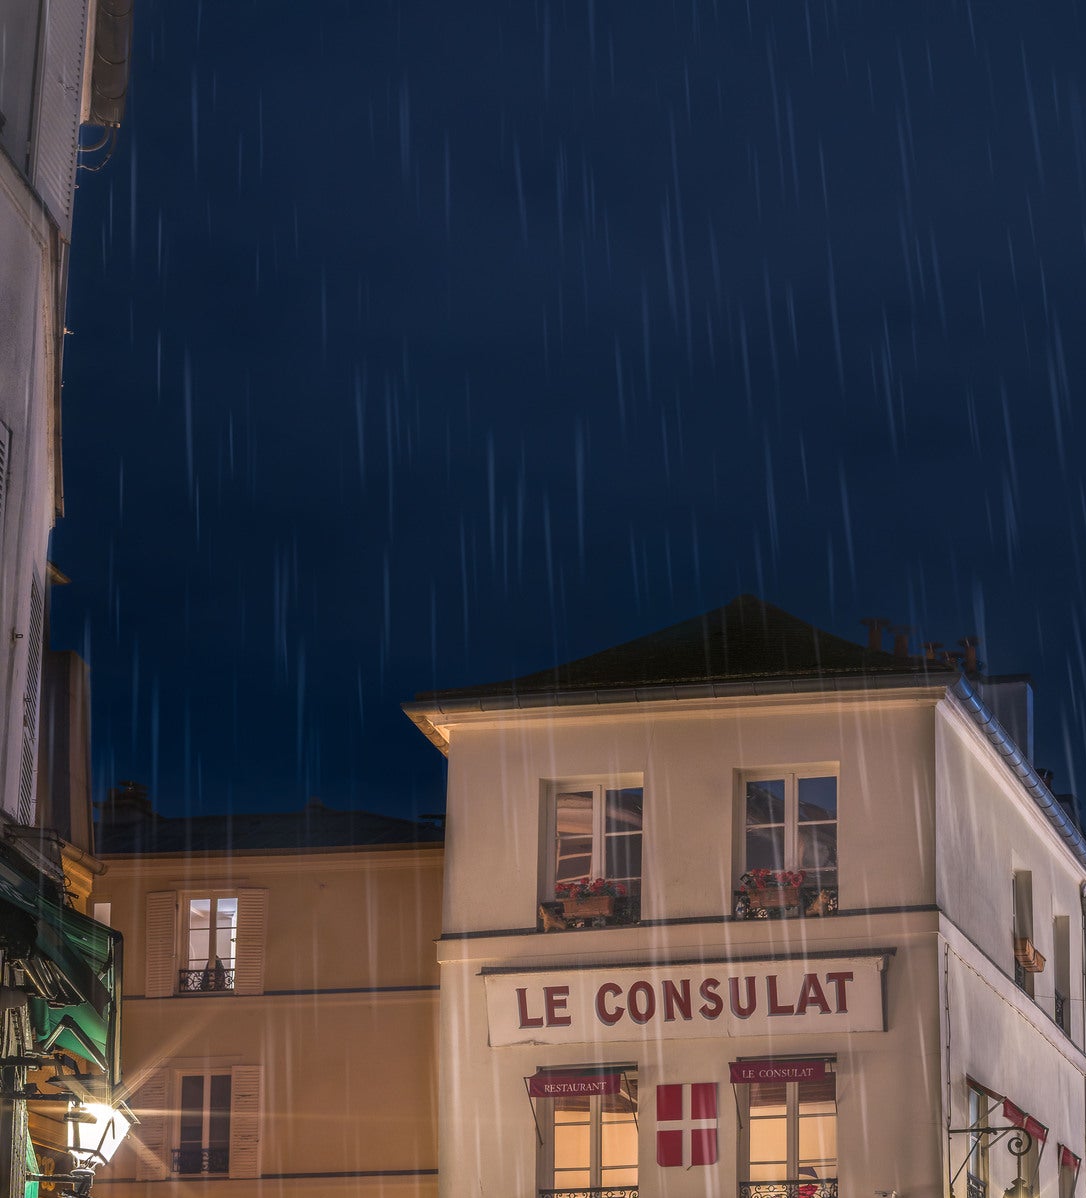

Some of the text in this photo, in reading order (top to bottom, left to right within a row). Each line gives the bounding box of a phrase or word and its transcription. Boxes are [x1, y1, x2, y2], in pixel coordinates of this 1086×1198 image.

[515, 971, 853, 1029] LE CONSULAT
[742, 1067, 814, 1079] LE CONSULAT
[543, 1081, 607, 1093] RESTAURANT
